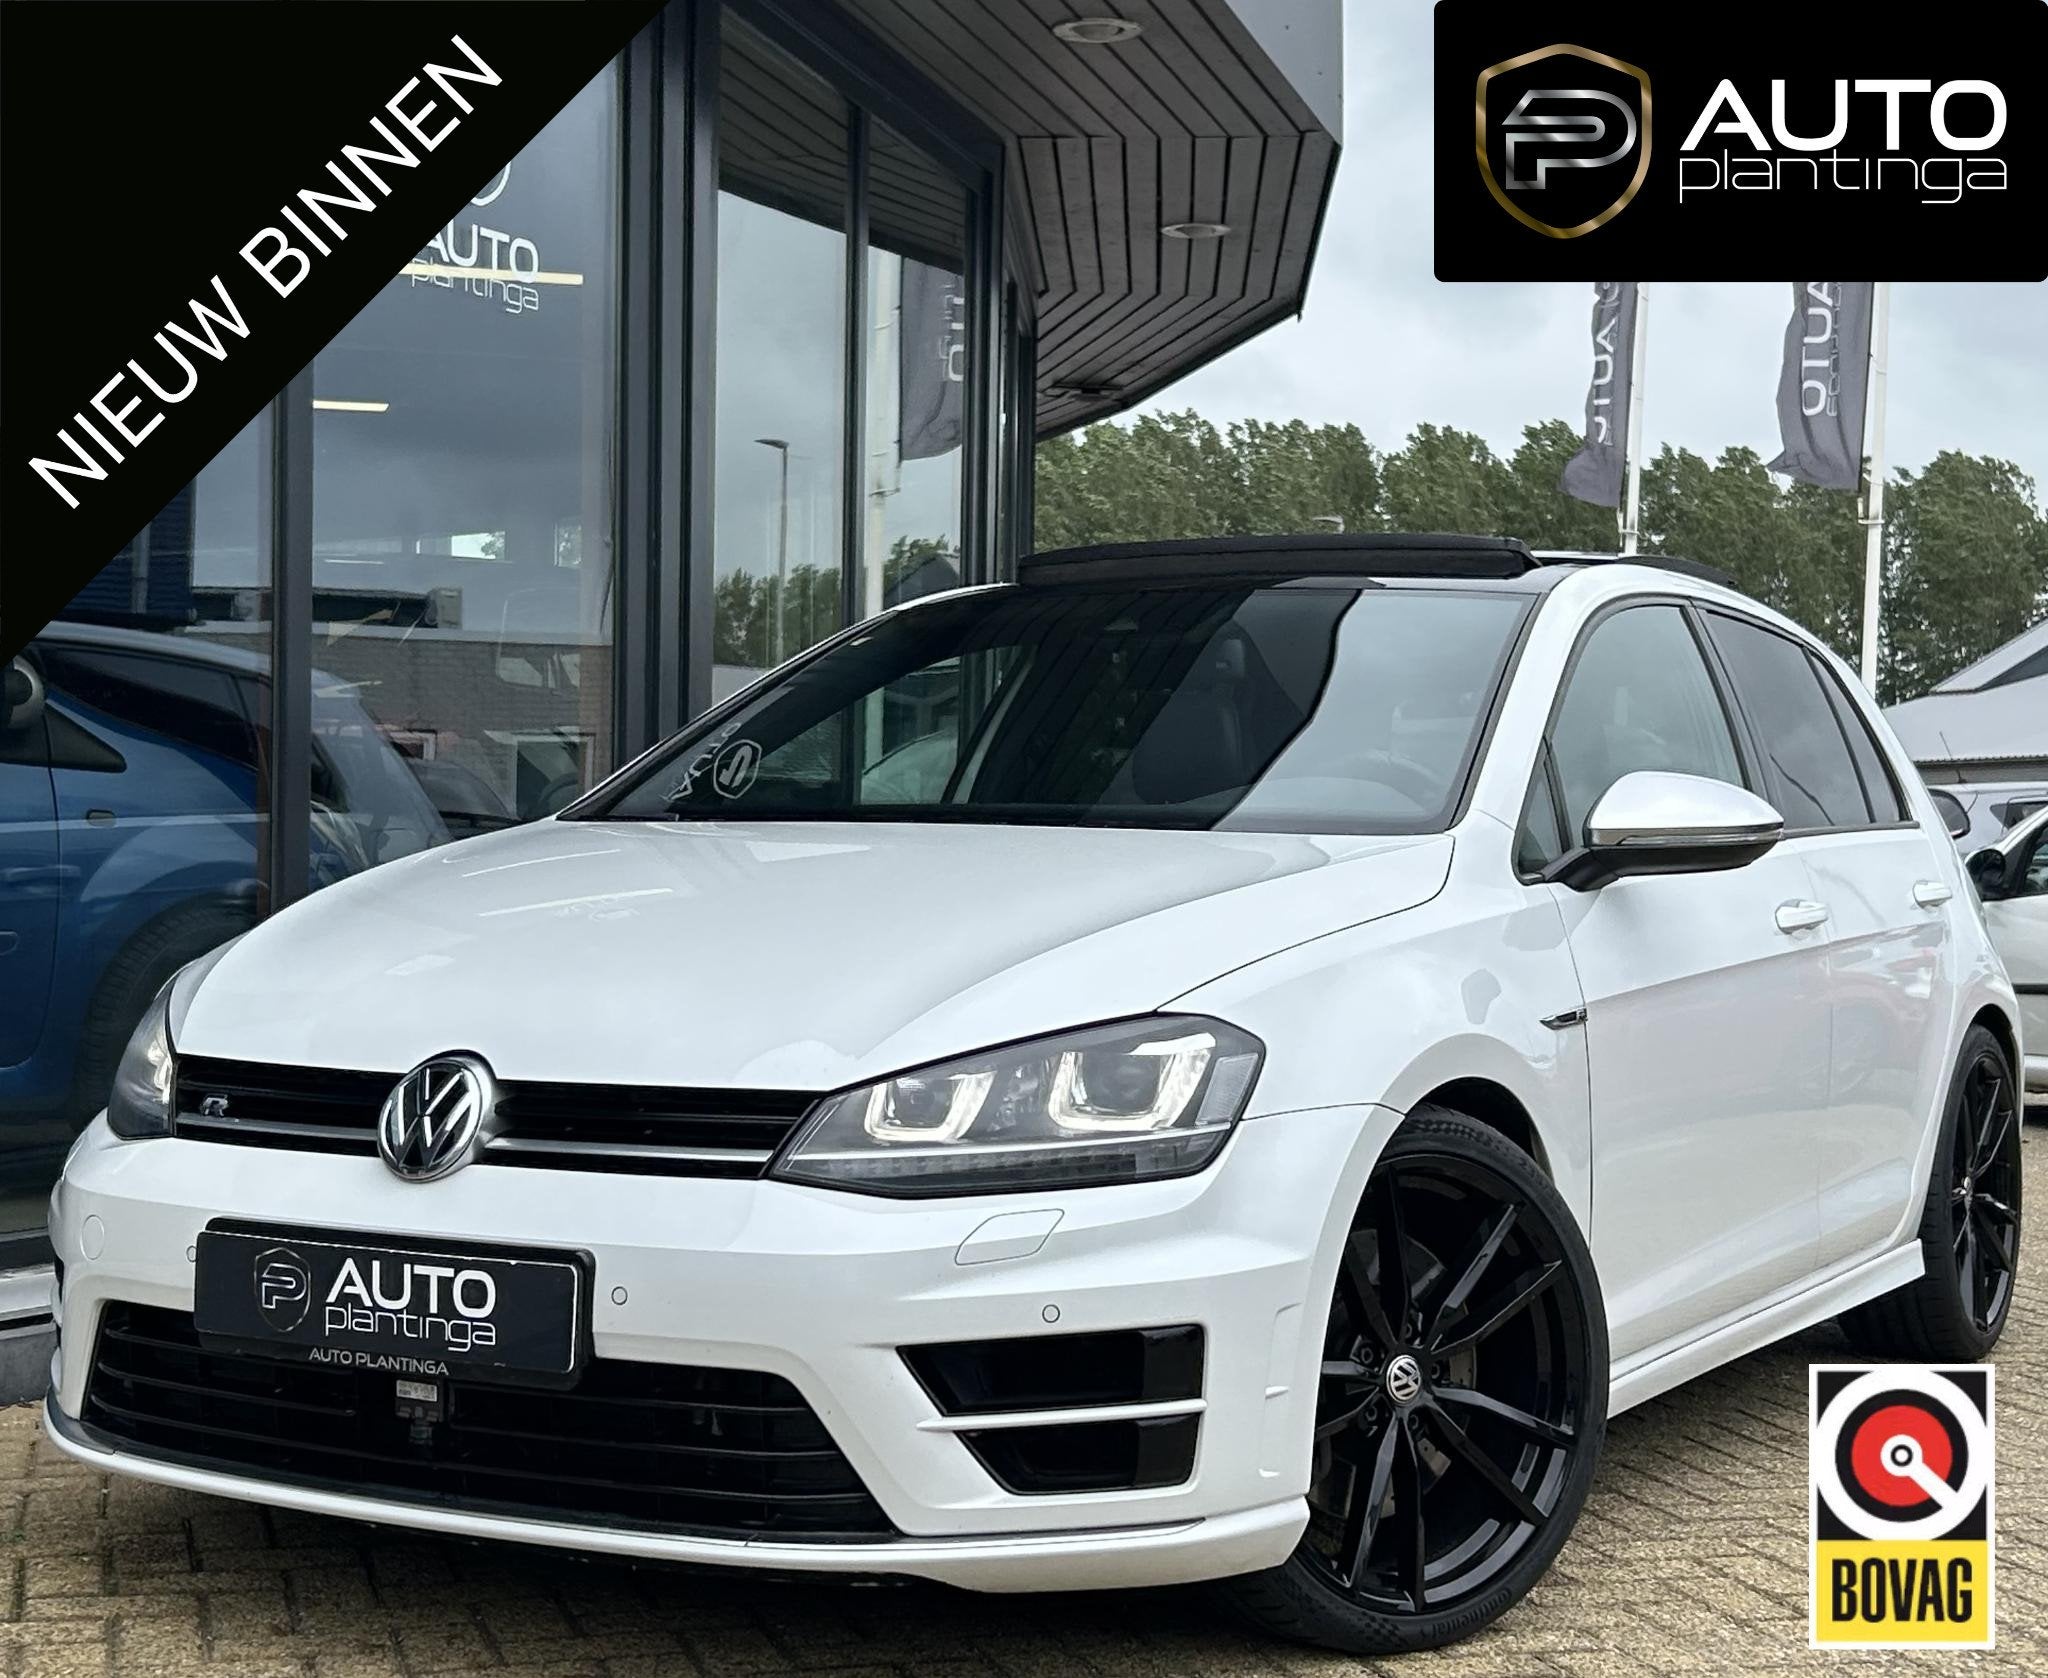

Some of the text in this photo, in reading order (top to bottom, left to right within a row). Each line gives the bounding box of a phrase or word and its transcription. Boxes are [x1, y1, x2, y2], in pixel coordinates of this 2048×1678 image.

[325, 1257, 496, 1319] AUTO
[325, 1303, 496, 1352] plantinga
[309, 1347, 449, 1376] AUTO PLANTINGA
